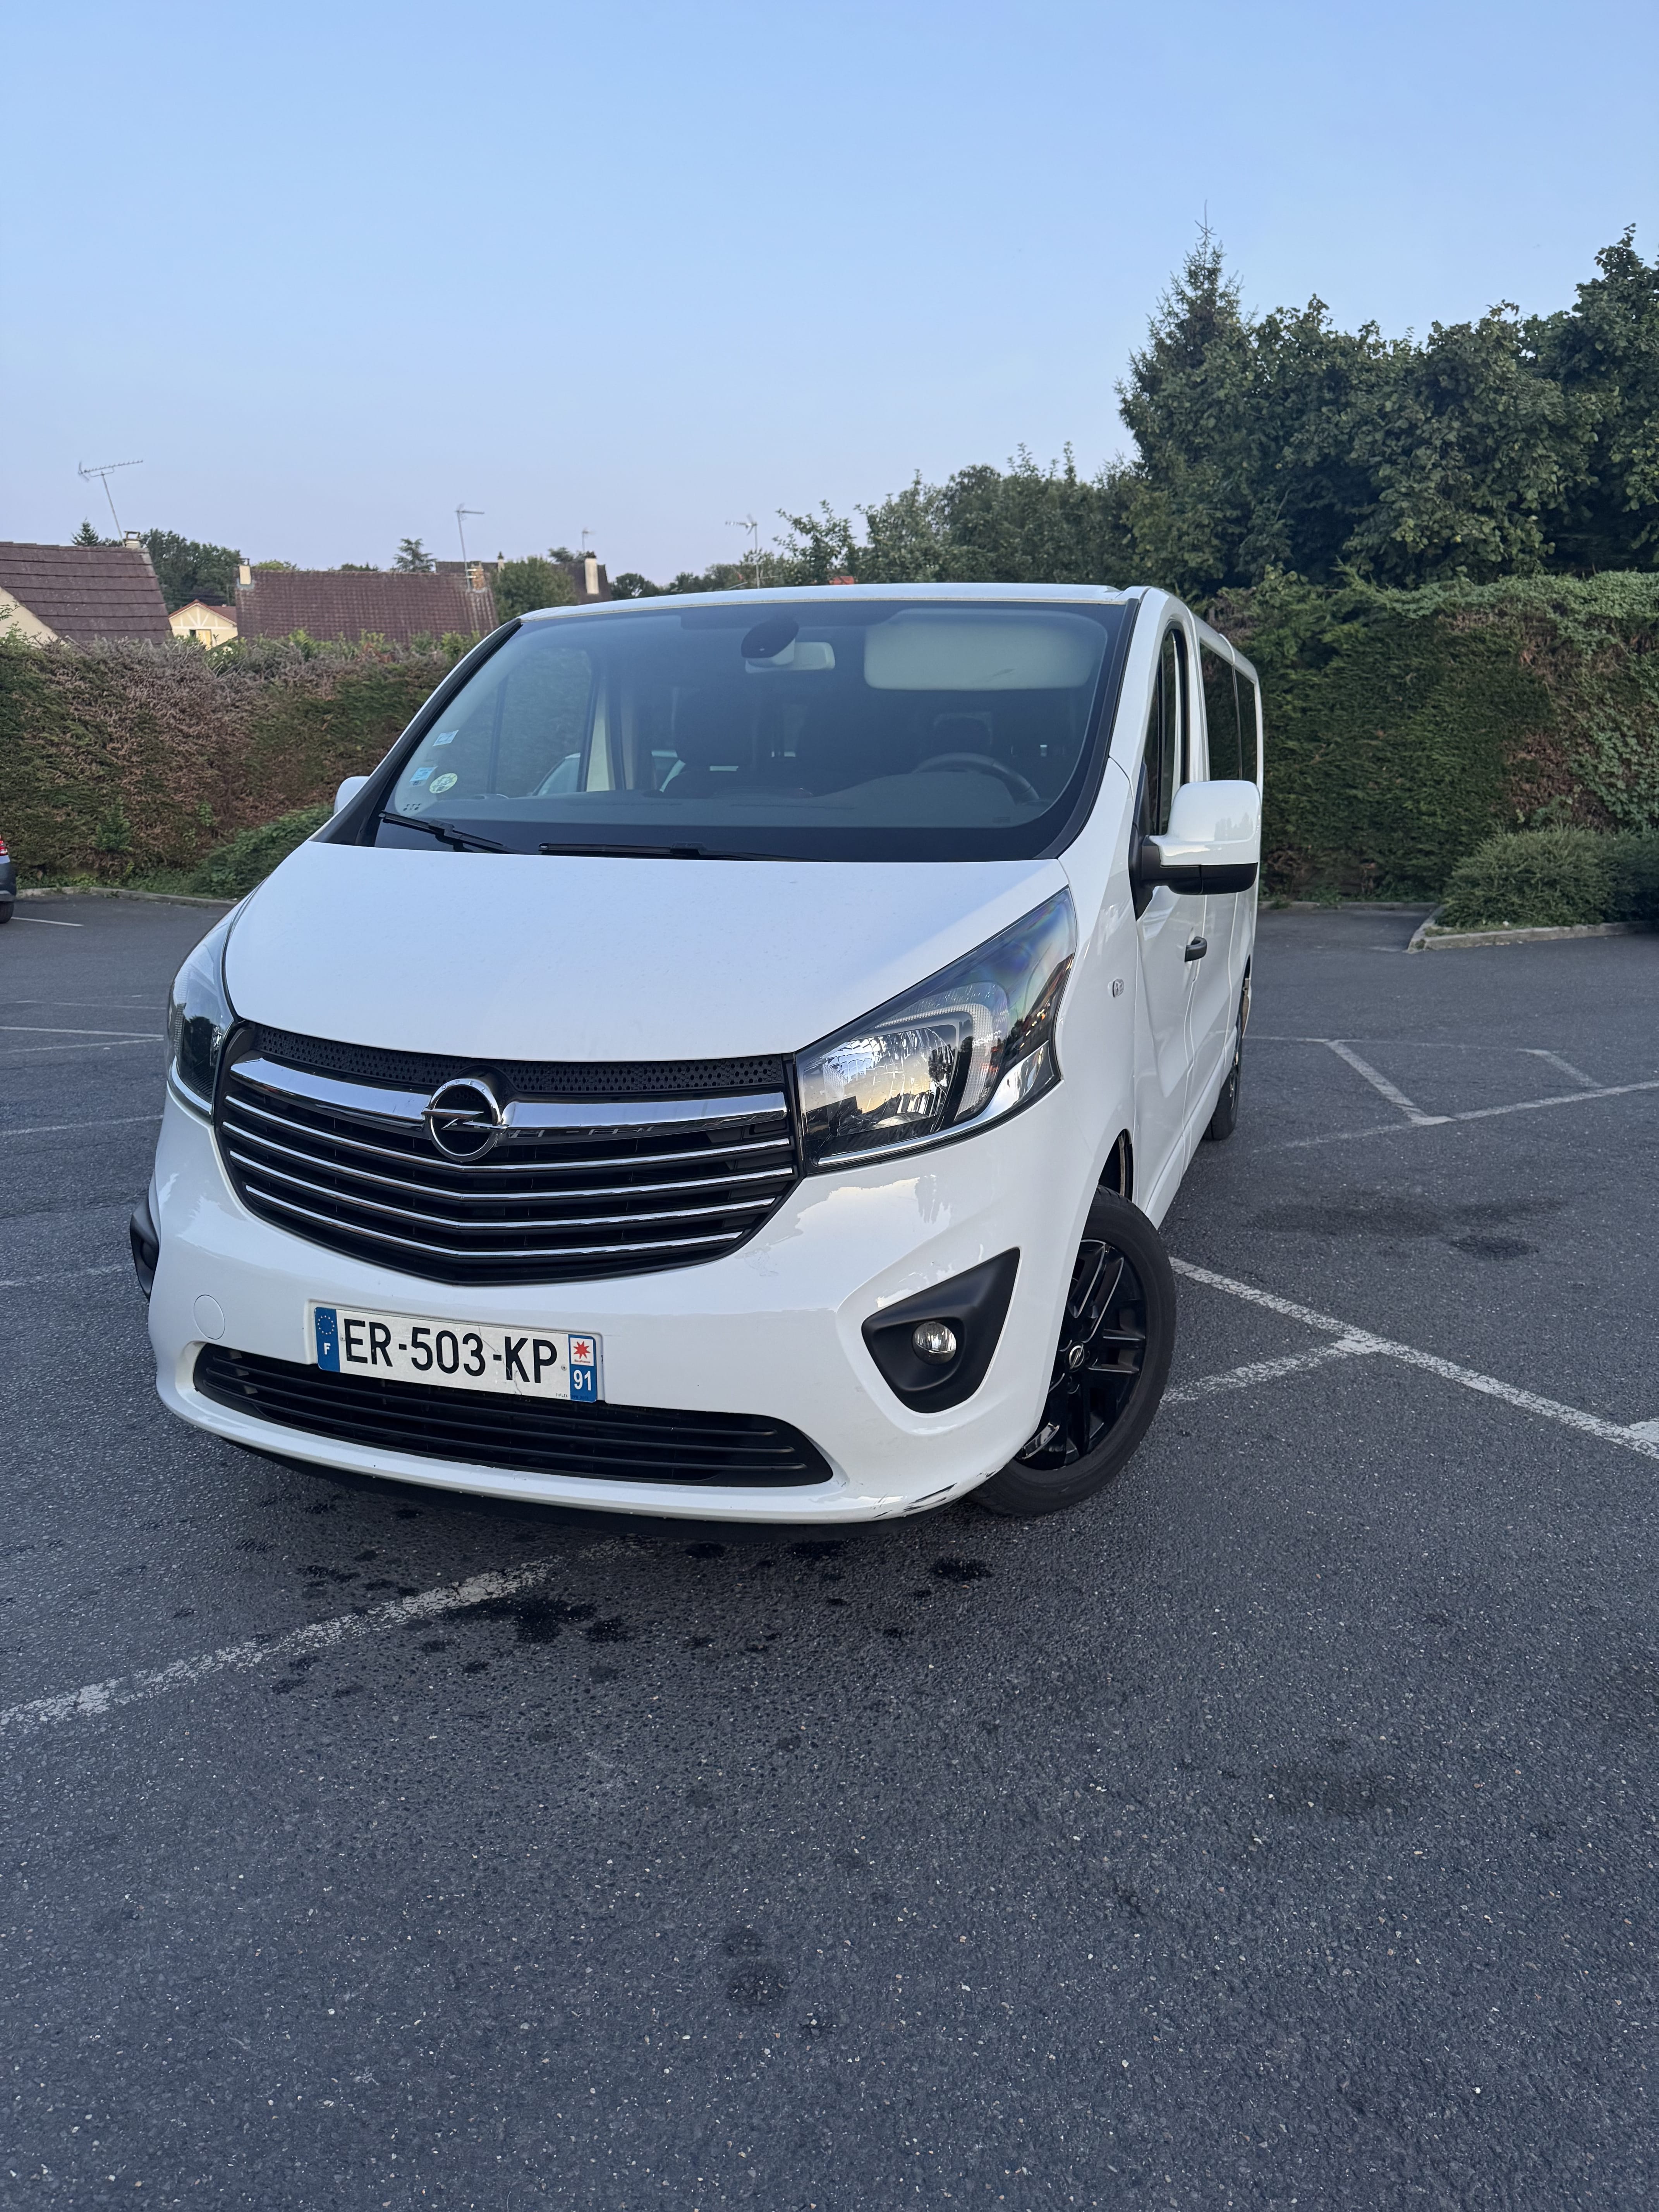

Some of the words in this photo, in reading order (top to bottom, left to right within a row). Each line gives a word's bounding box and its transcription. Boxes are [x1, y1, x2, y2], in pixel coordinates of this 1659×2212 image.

[441, 1080, 486, 1094] OPEL
[324, 1342, 331, 1355] F
[344, 1318, 558, 1384] ER-503-KP
[573, 1369, 591, 1391] 91
